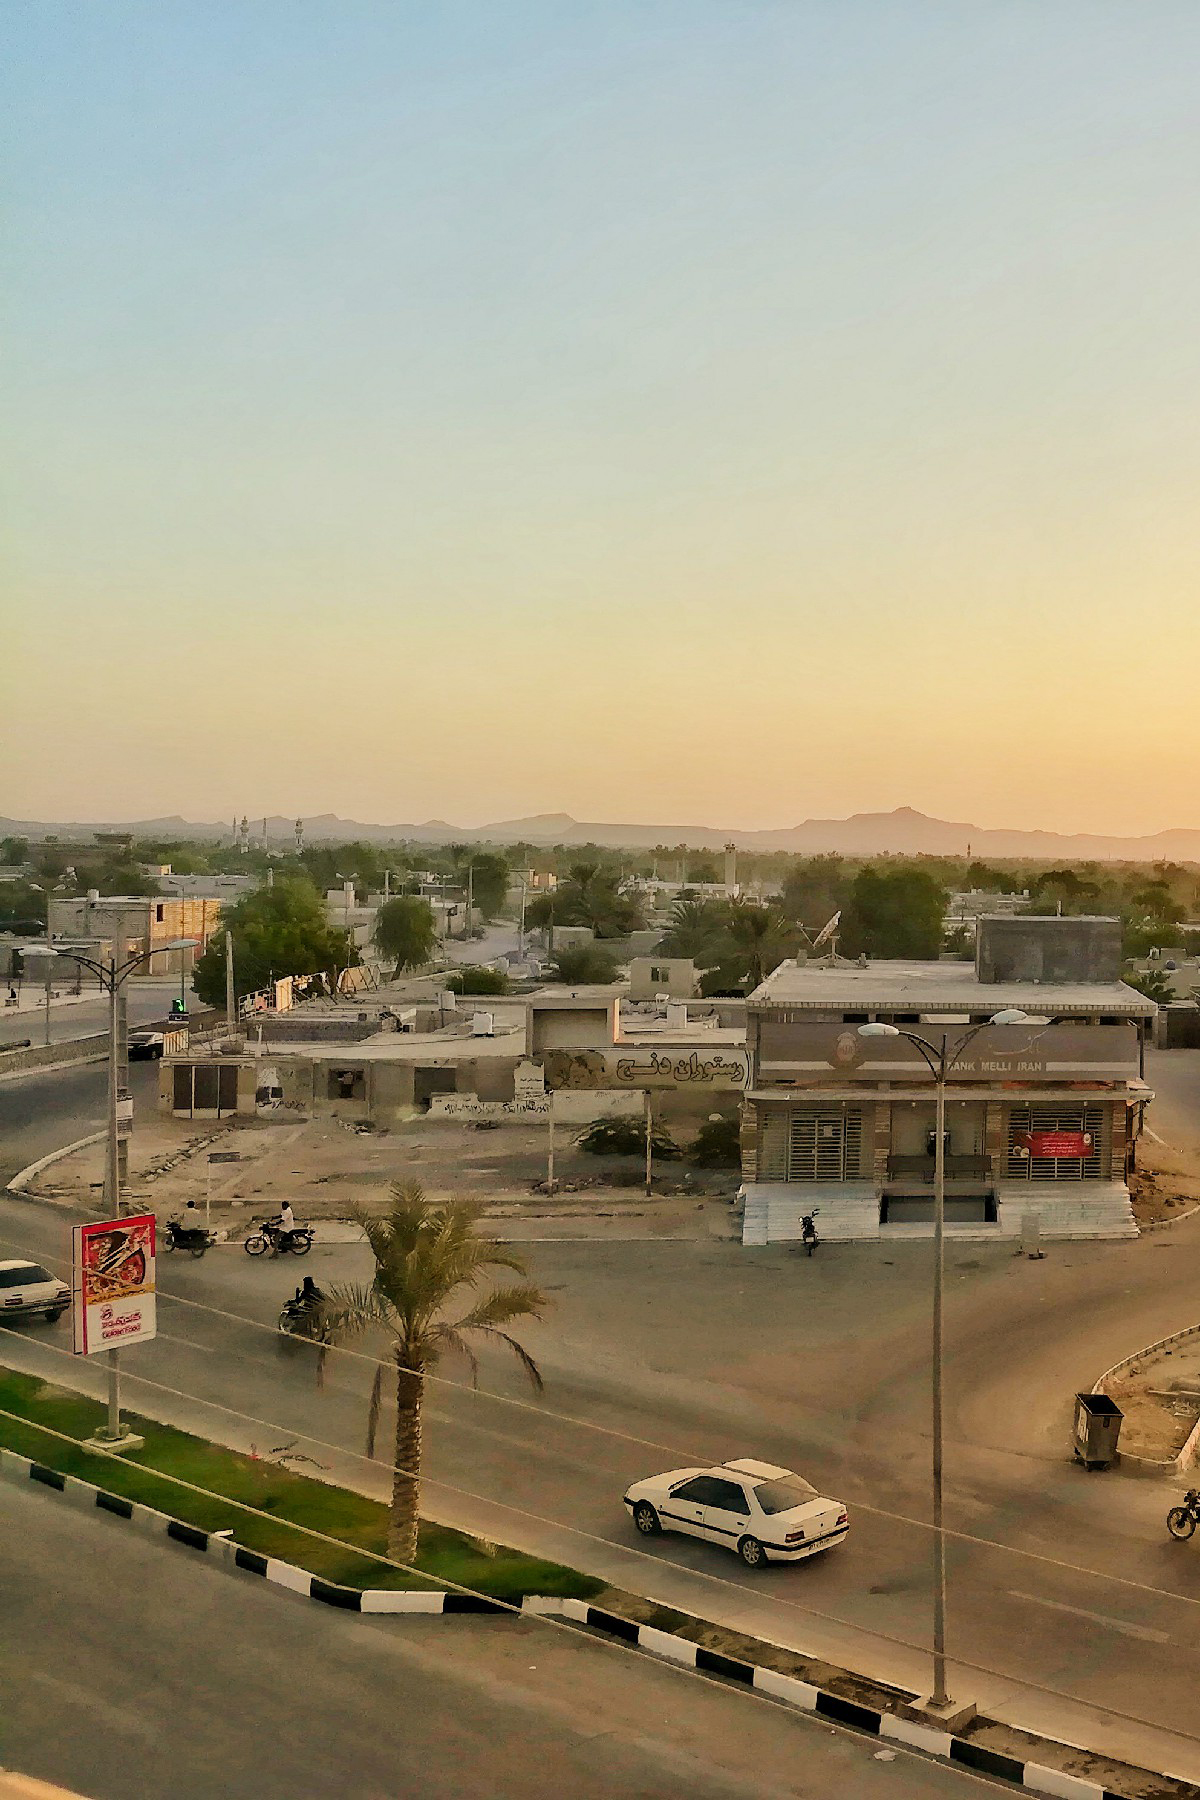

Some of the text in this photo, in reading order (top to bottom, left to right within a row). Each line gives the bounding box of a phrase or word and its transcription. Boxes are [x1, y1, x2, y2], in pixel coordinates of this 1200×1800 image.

[673, 1052, 745, 1082] رستوران
[982, 1061, 1012, 1071] MELLI
[1017, 1061, 1042, 1071] IRAN
